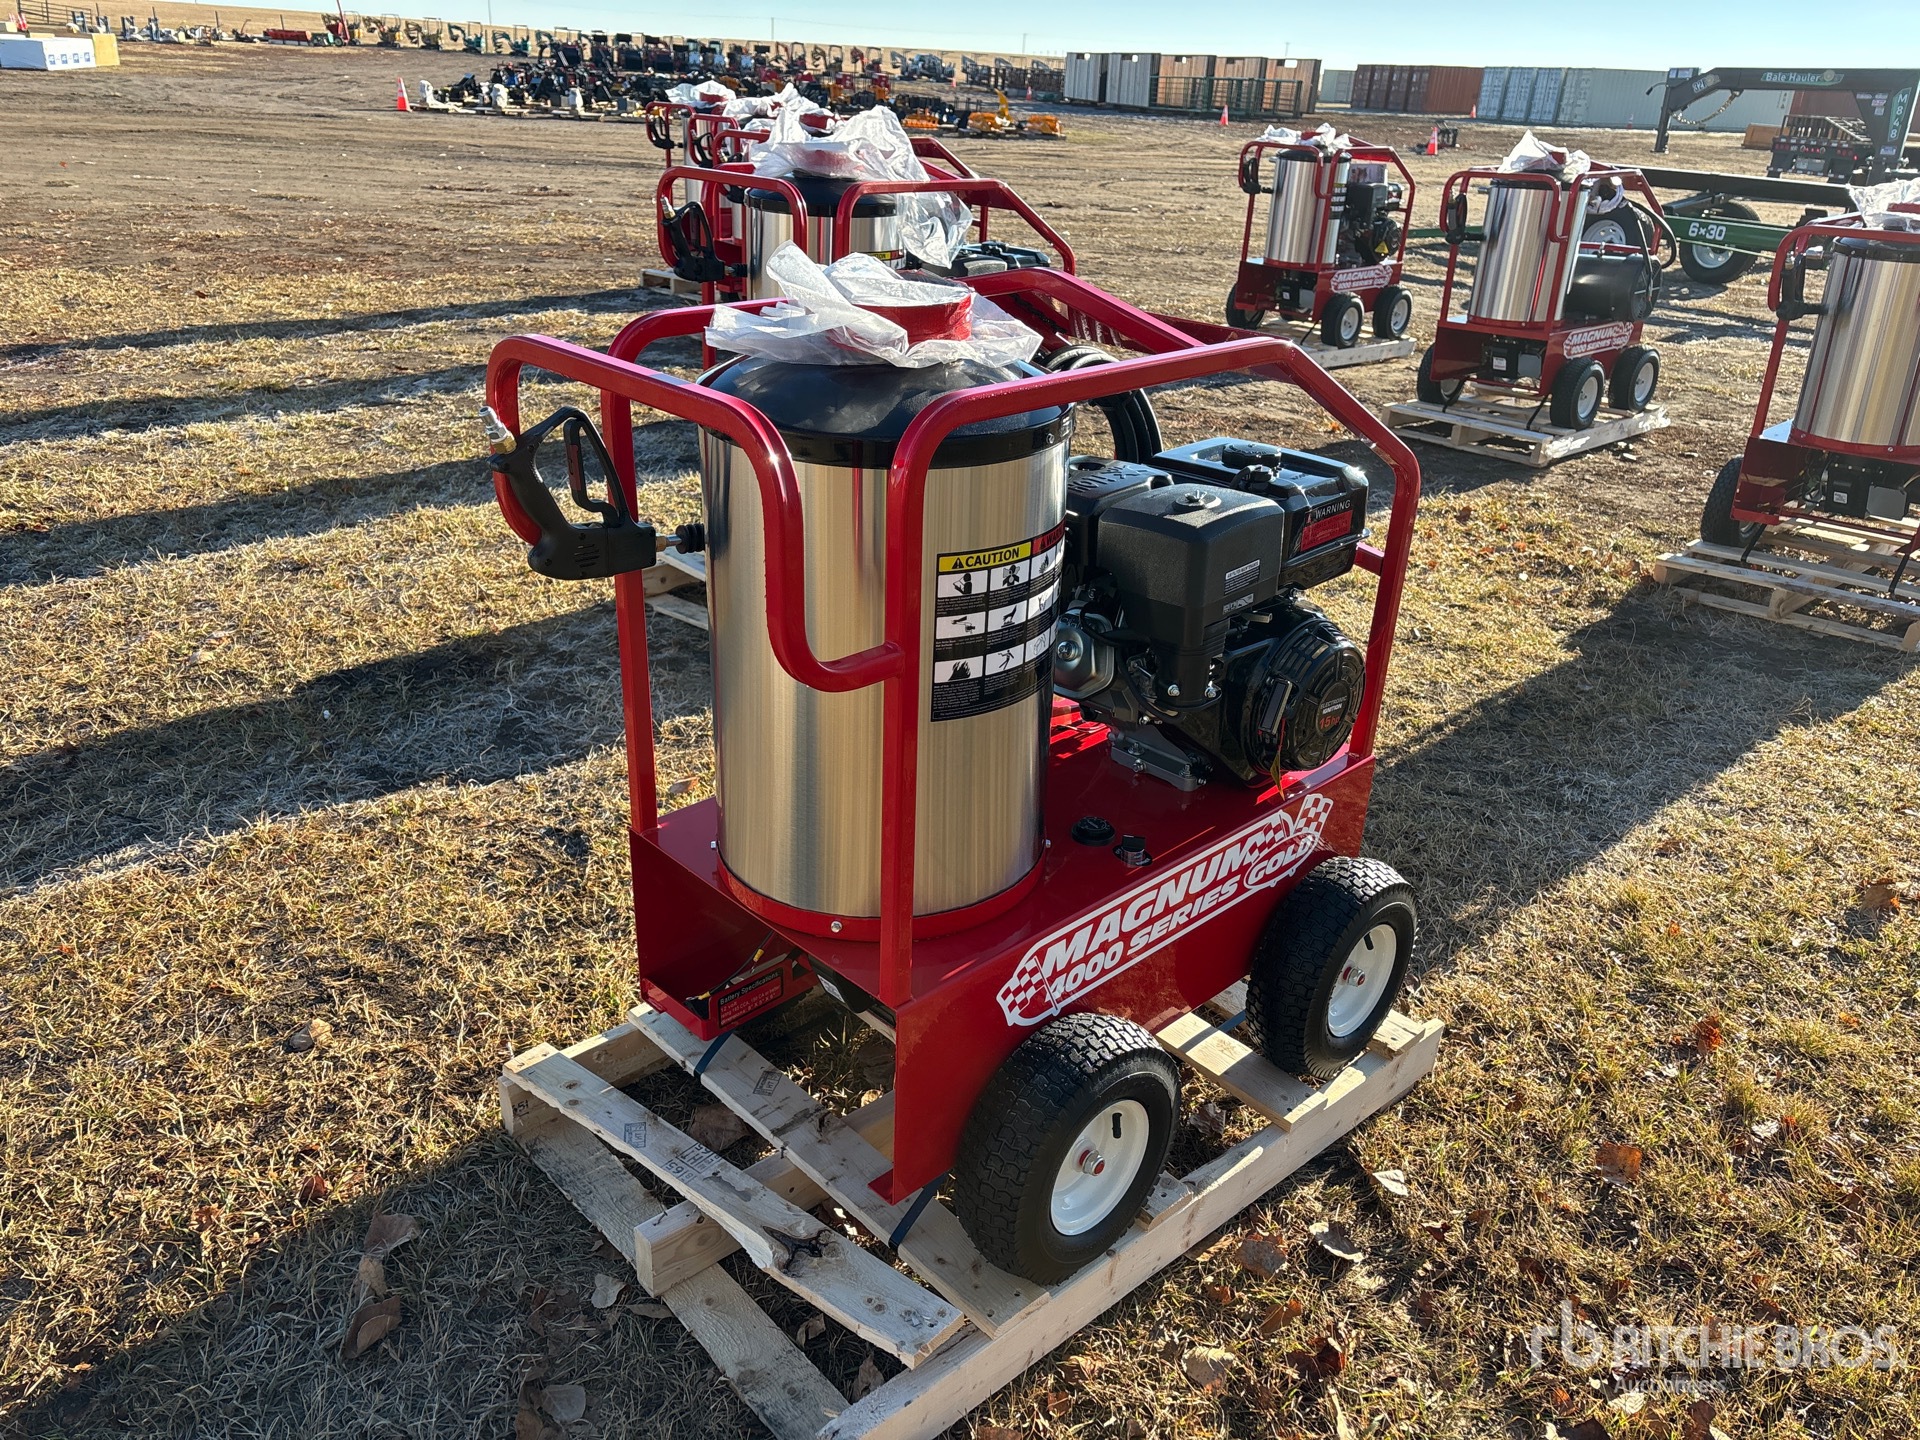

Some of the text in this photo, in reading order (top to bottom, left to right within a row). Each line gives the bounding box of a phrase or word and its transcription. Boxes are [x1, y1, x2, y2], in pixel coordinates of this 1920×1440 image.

[1766, 72, 1821, 82] Bale Hauler
[1338, 270, 1379, 282] MAGNUM
[1571, 326, 1617, 345] MAGNUM
[1587, 339, 1611, 350] SERIES
[1315, 499, 1351, 520] WARNING
[965, 547, 1021, 567] CAUTION
[1247, 834, 1314, 885] GOLD
[1041, 837, 1260, 978] MAGNUM
[1045, 873, 1241, 1003] 4000 SERIES
[720, 989, 741, 1005] Battery
